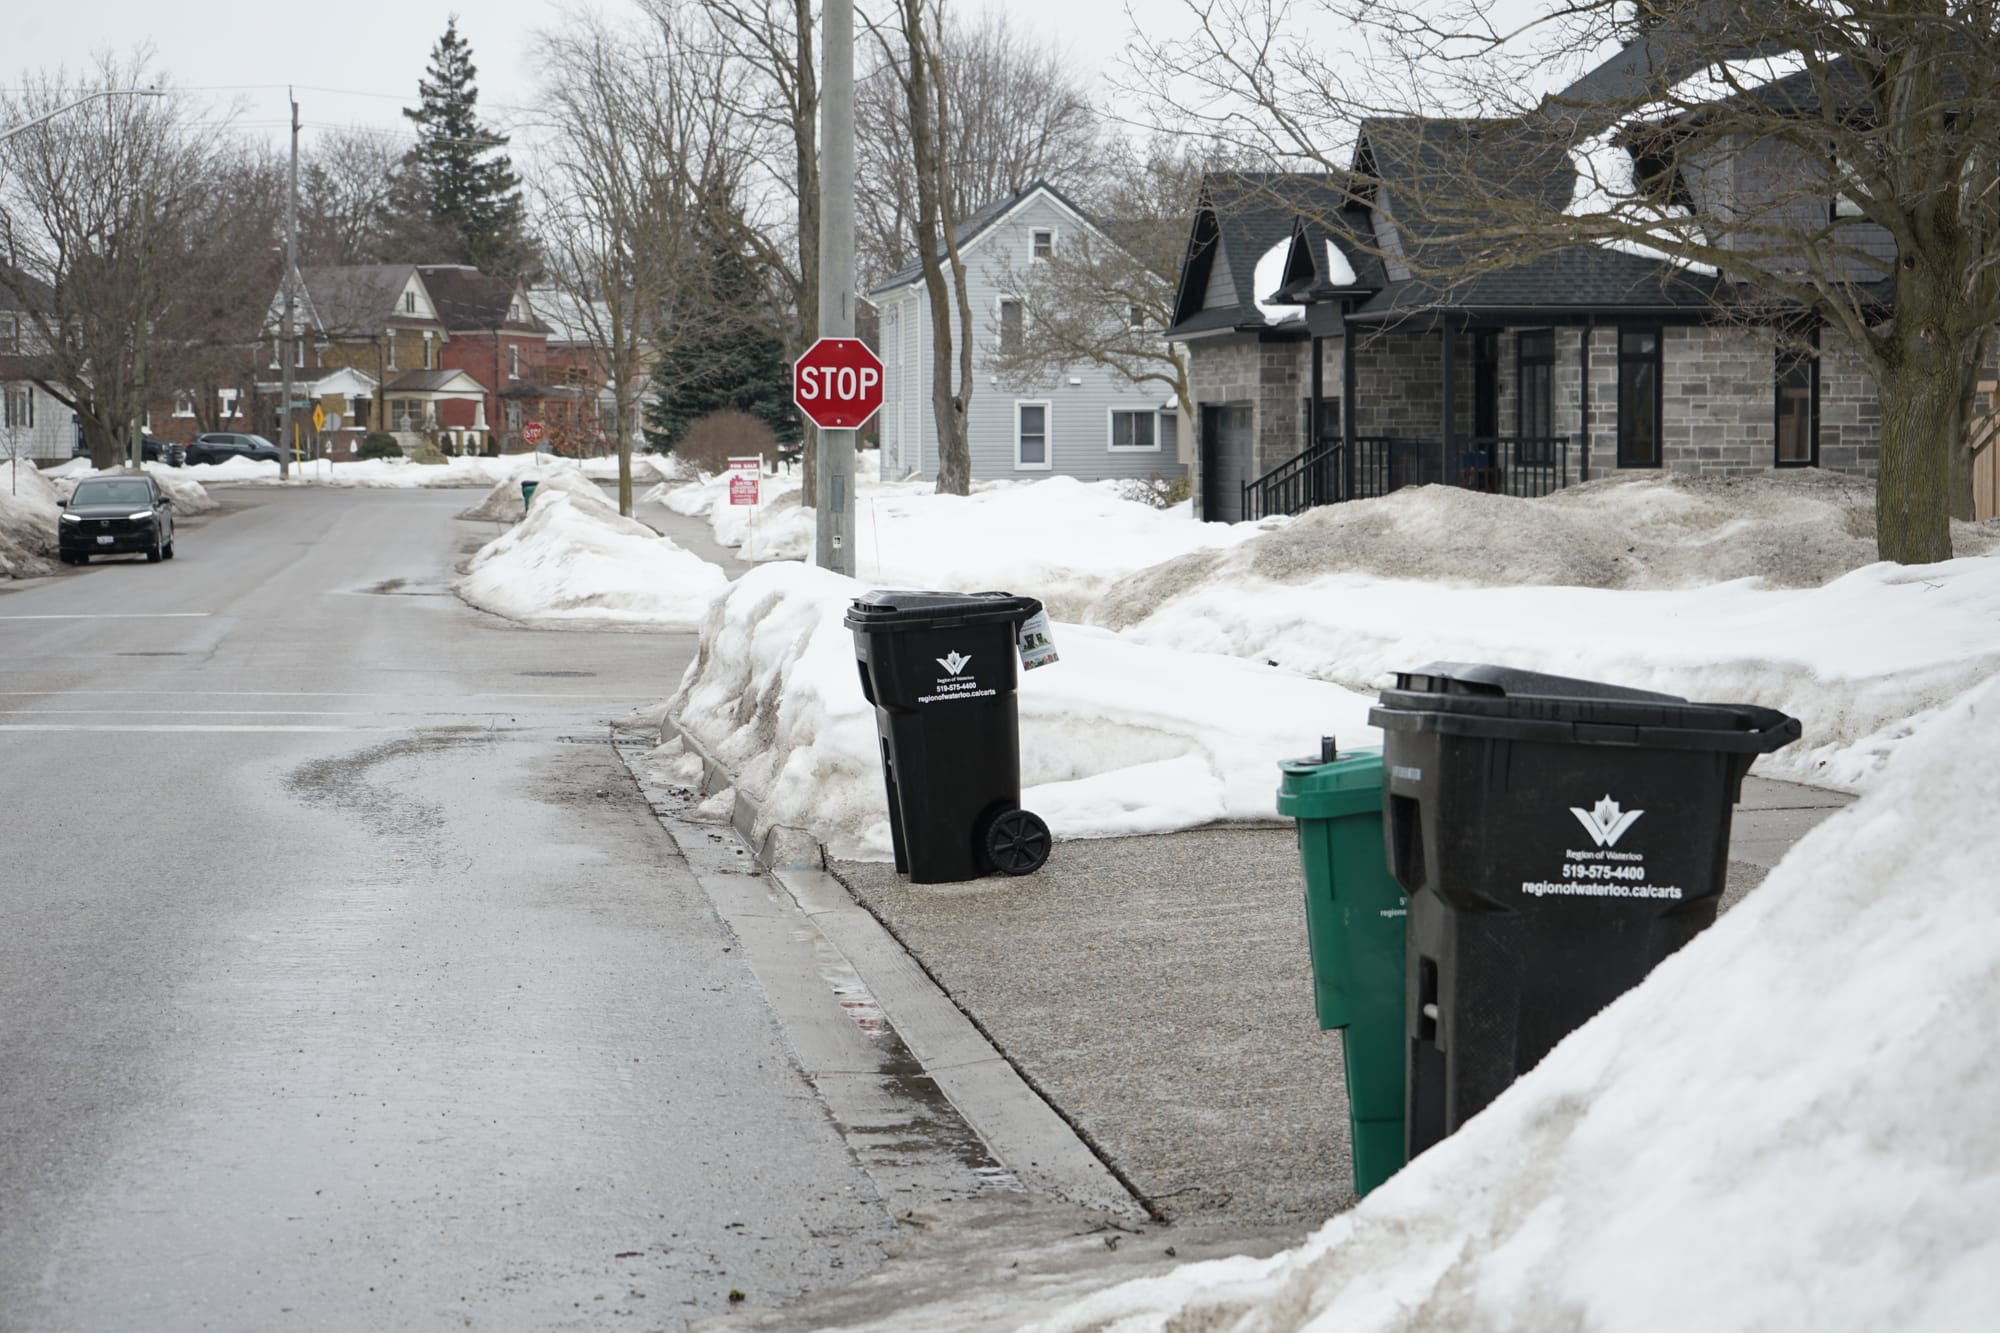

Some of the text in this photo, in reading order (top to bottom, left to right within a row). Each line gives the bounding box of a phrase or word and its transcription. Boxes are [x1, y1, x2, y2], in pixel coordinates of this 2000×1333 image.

[801, 366, 879, 400] STOP
[936, 682, 976, 692] 519-575-4400
[918, 689, 996, 703] regionofwaterloo.ca/carts
[1566, 849, 1643, 861] Region of Waterloo
[1562, 864, 1645, 881] 519-575-4400
[1522, 880, 1683, 899] regionofwaterloo.ca/carts
